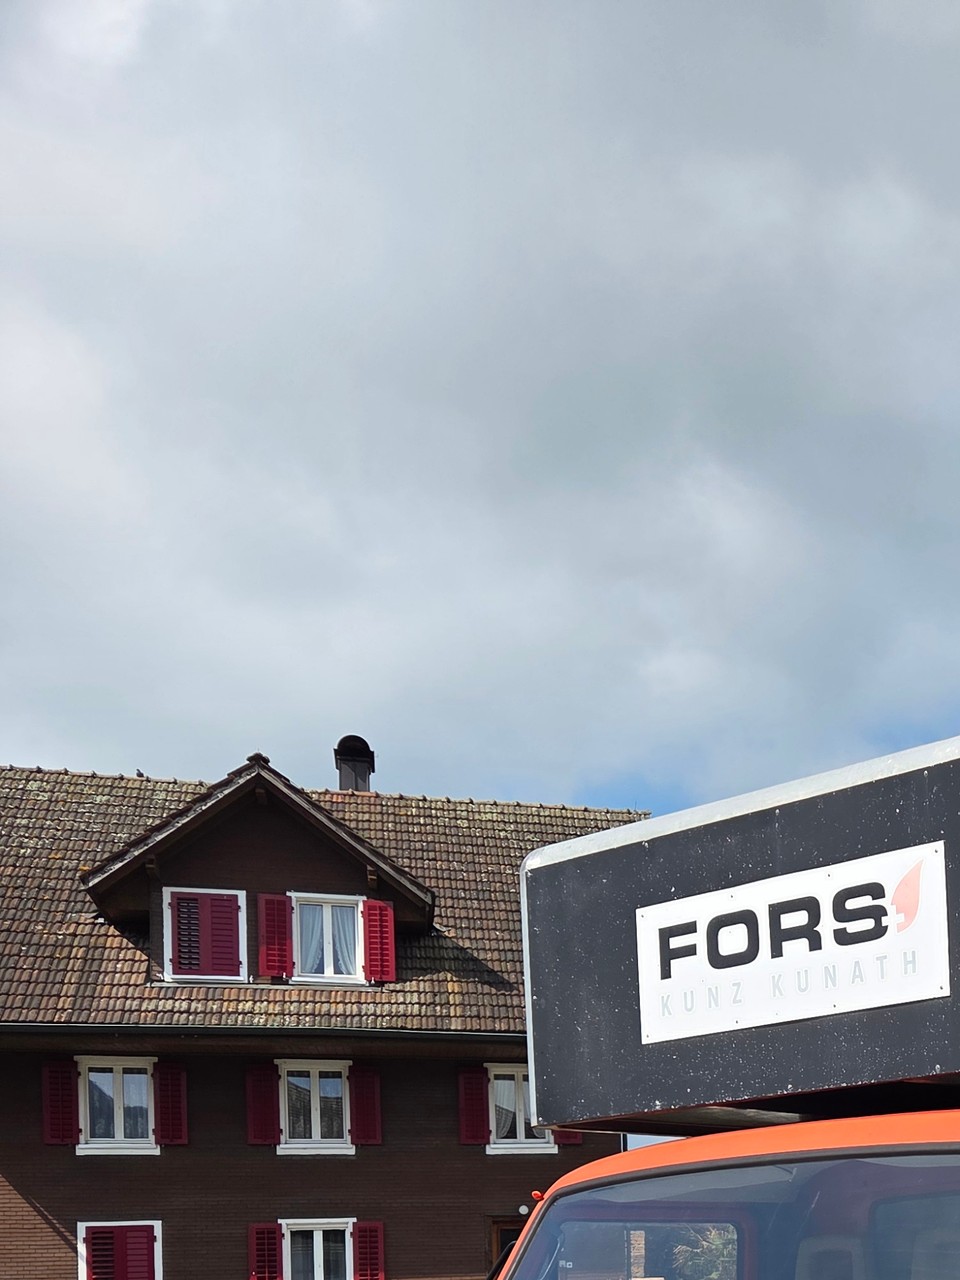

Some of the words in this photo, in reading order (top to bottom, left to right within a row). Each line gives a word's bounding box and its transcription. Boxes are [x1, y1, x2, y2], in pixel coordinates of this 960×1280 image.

[658, 882, 889, 980] FORS
[660, 982, 742, 1017] KUNZ
[771, 950, 917, 997] KUNATH
